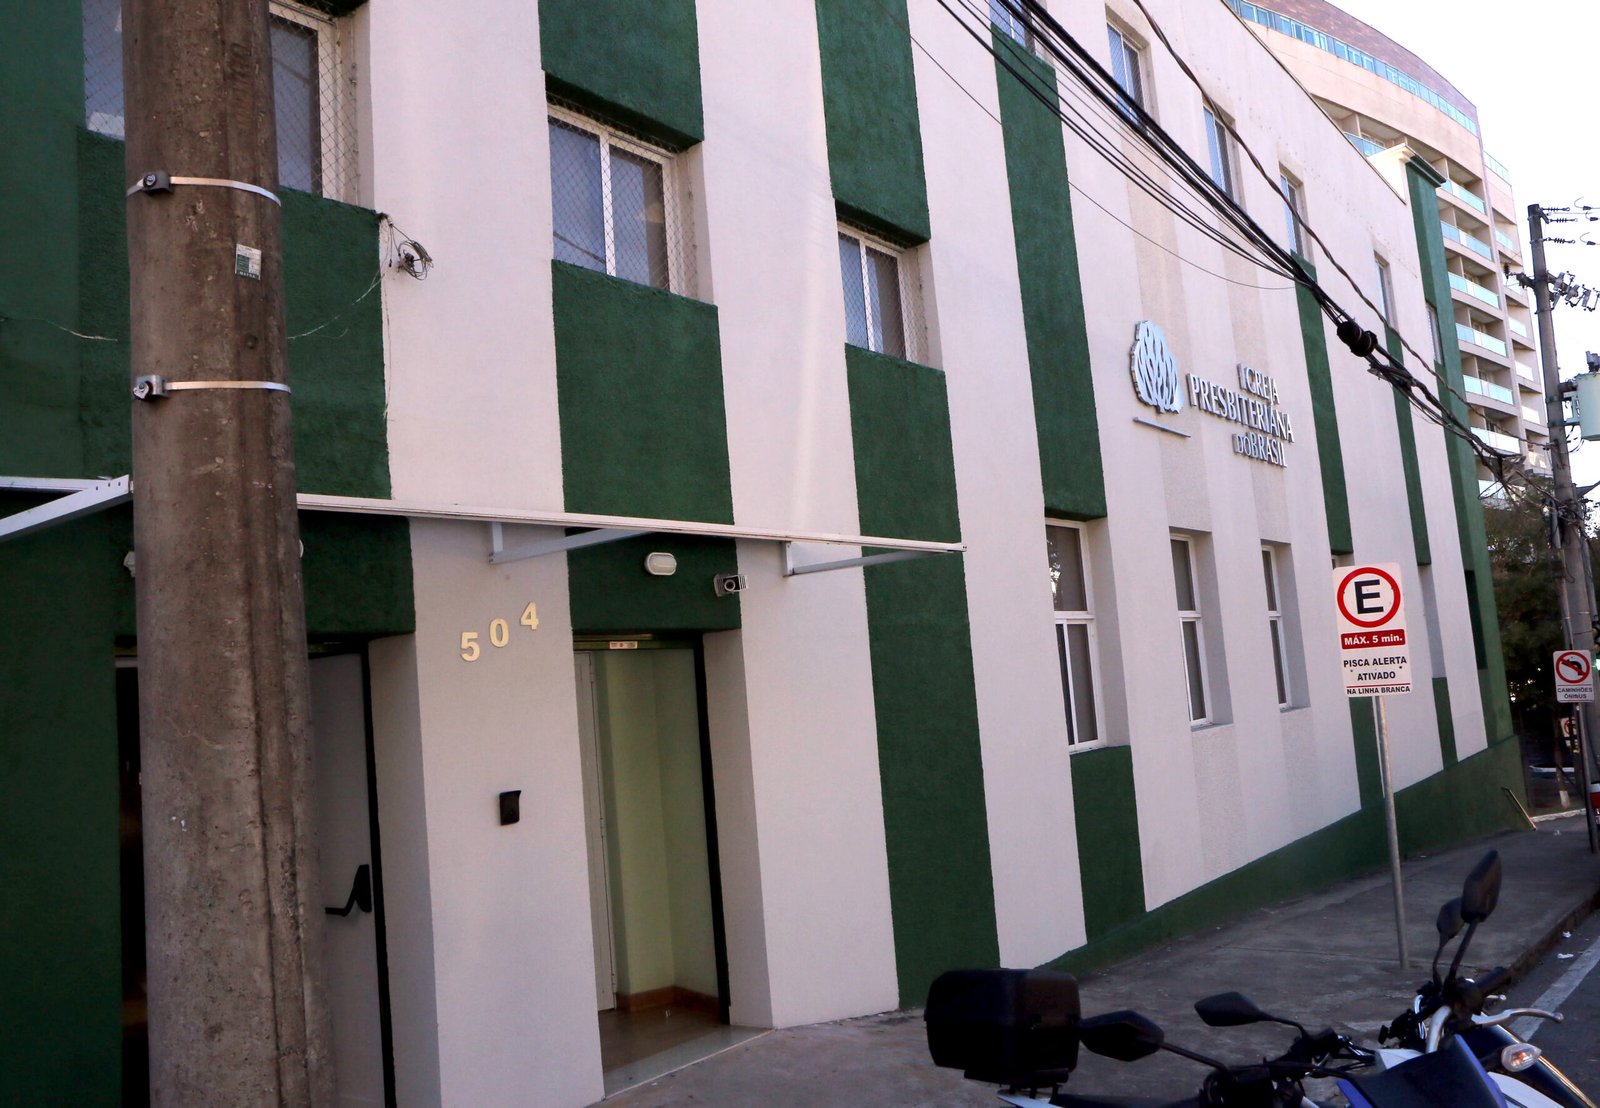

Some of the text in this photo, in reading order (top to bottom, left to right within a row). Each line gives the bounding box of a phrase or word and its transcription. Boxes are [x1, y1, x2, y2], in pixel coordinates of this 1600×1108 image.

[1186, 373, 1294, 442] PRESBITERIANA
[1354, 578, 1384, 614] E
[1372, 635, 1379, 643] 5
[1381, 633, 1403, 643] min.
[1343, 656, 1407, 668] PISCA ALERTA
[1357, 671, 1396, 681] ATIVADO
[1358, 687, 1380, 695] LINHA
[1380, 685, 1411, 694] BRANCA
